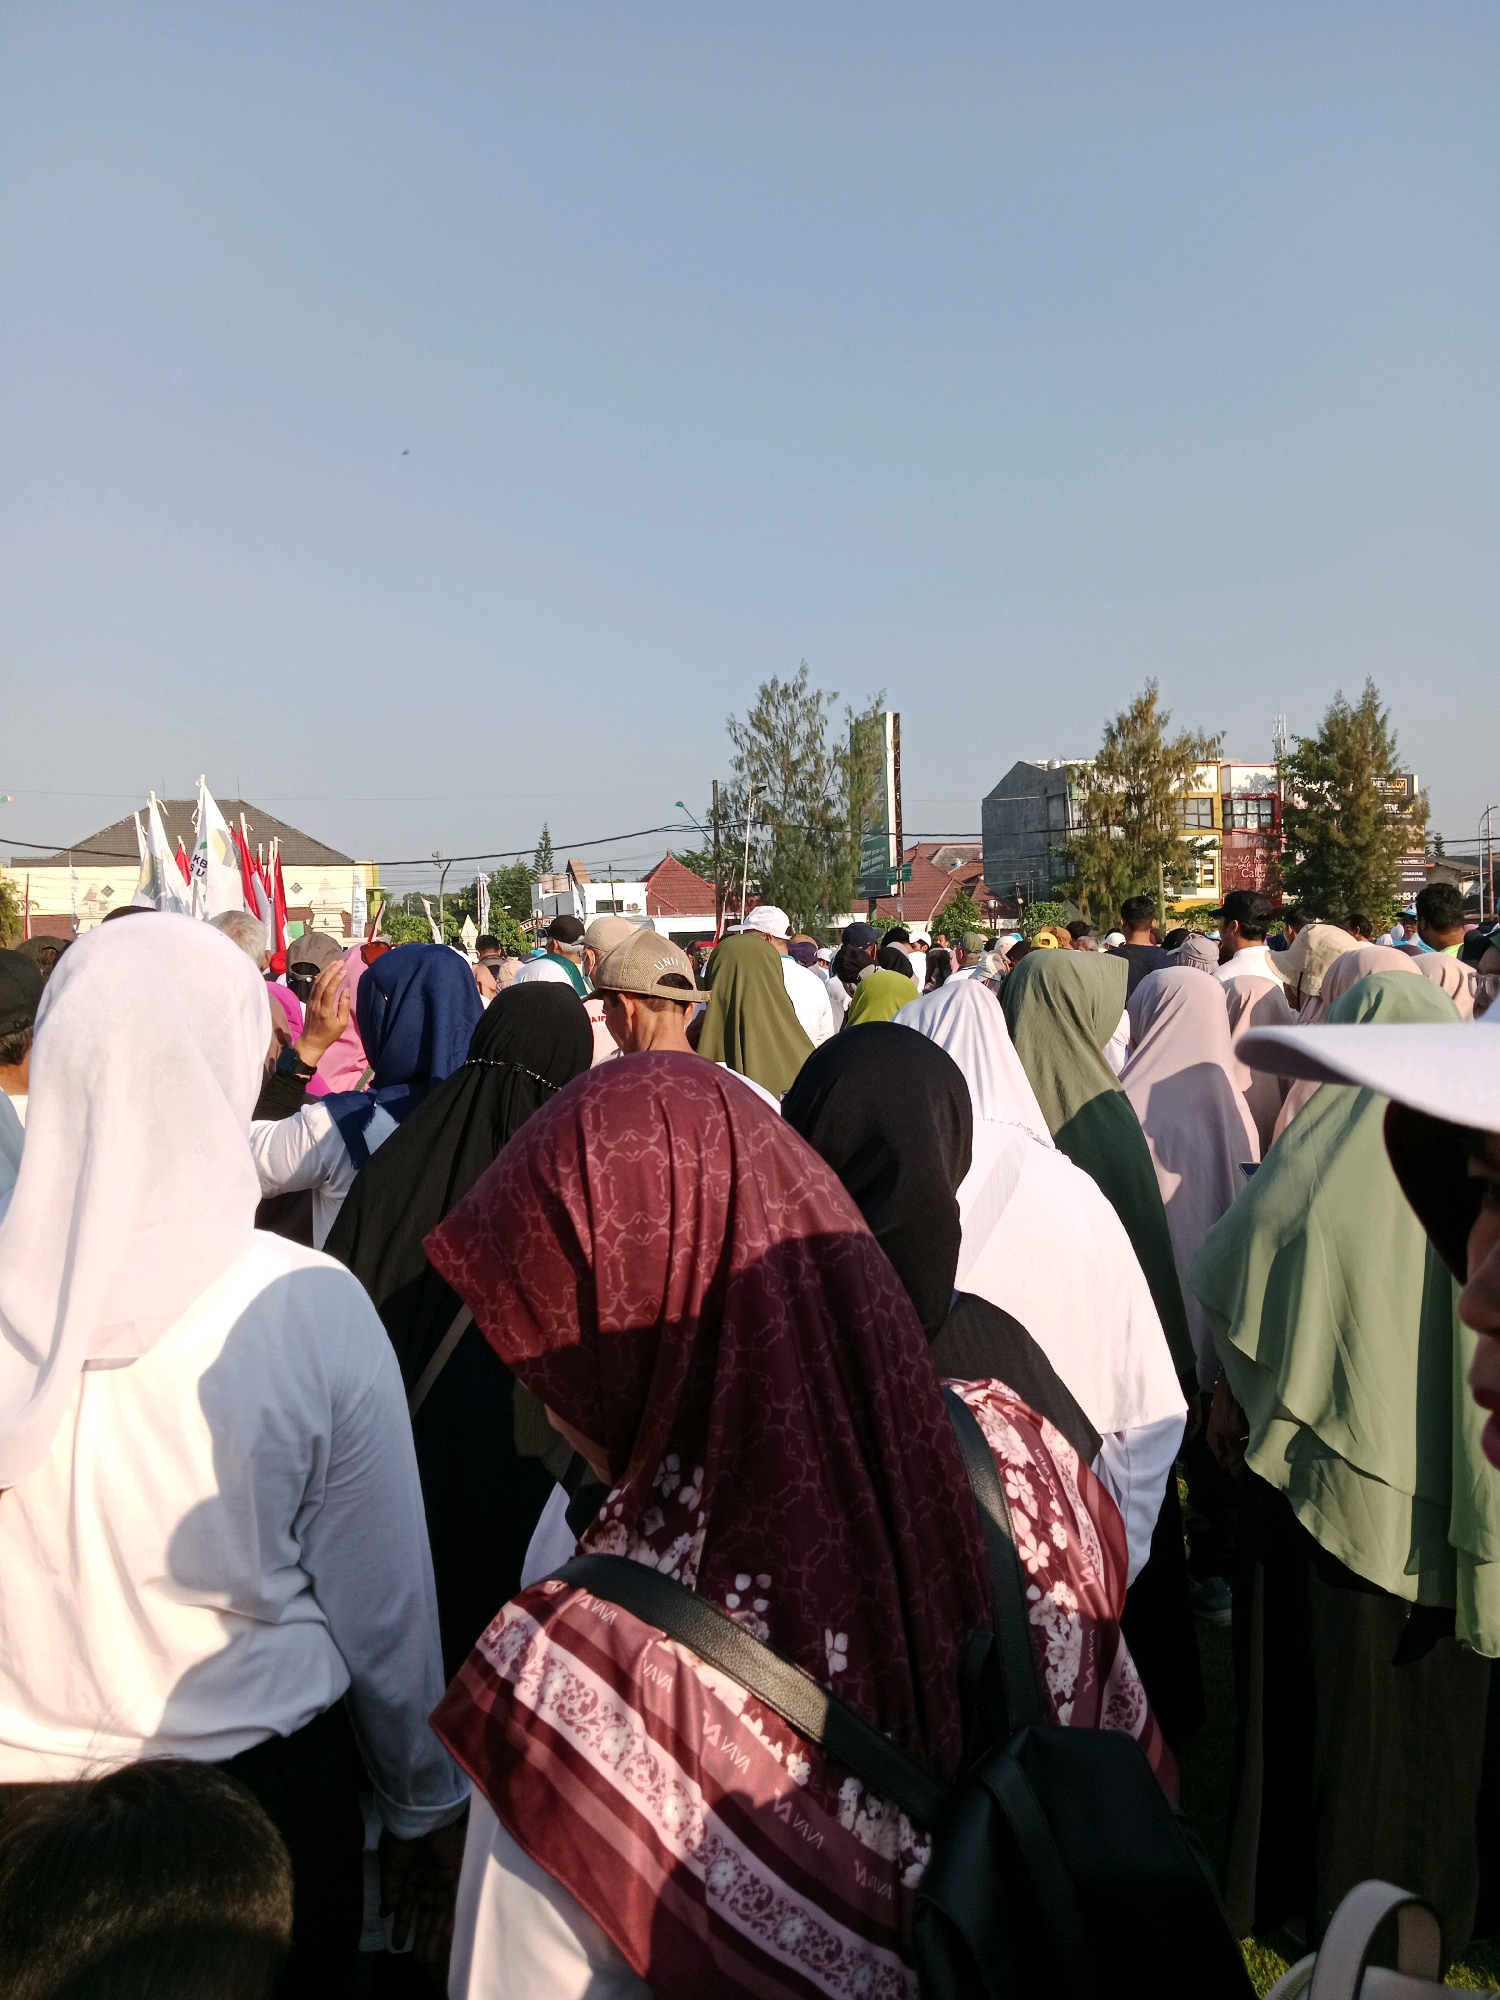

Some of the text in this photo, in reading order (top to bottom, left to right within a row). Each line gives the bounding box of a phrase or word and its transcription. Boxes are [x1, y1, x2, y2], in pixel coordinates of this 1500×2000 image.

[591, 1599, 618, 1626] VAVA
[642, 1659, 674, 1693] VAVA
[720, 1736, 751, 1775] VAVA
[793, 1813, 824, 1850] VAVA
